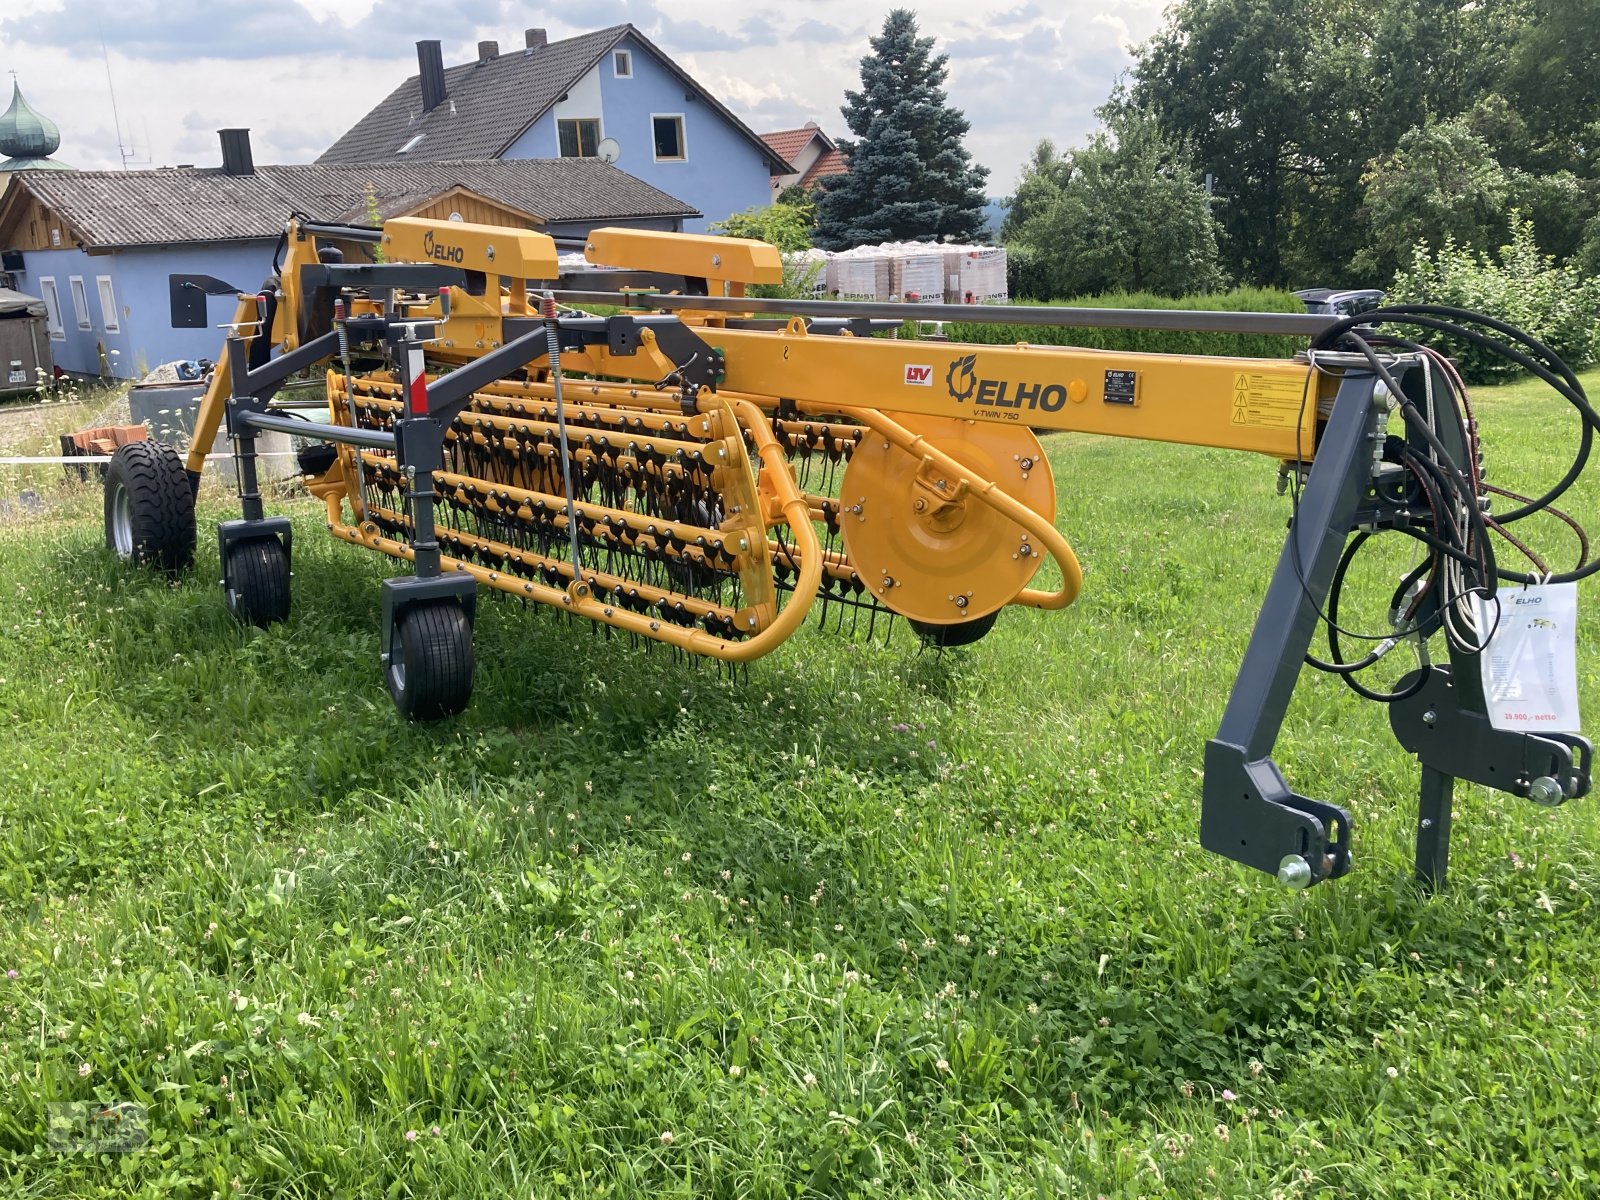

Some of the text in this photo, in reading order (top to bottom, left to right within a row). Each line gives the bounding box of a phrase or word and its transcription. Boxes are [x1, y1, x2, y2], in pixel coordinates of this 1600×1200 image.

[434, 243, 464, 264] ELHO
[906, 367, 931, 381] LTV
[975, 379, 1068, 413] ELHO
[973, 409, 1020, 421] V-TWIN 750
[1515, 597, 1542, 605] ELHO
